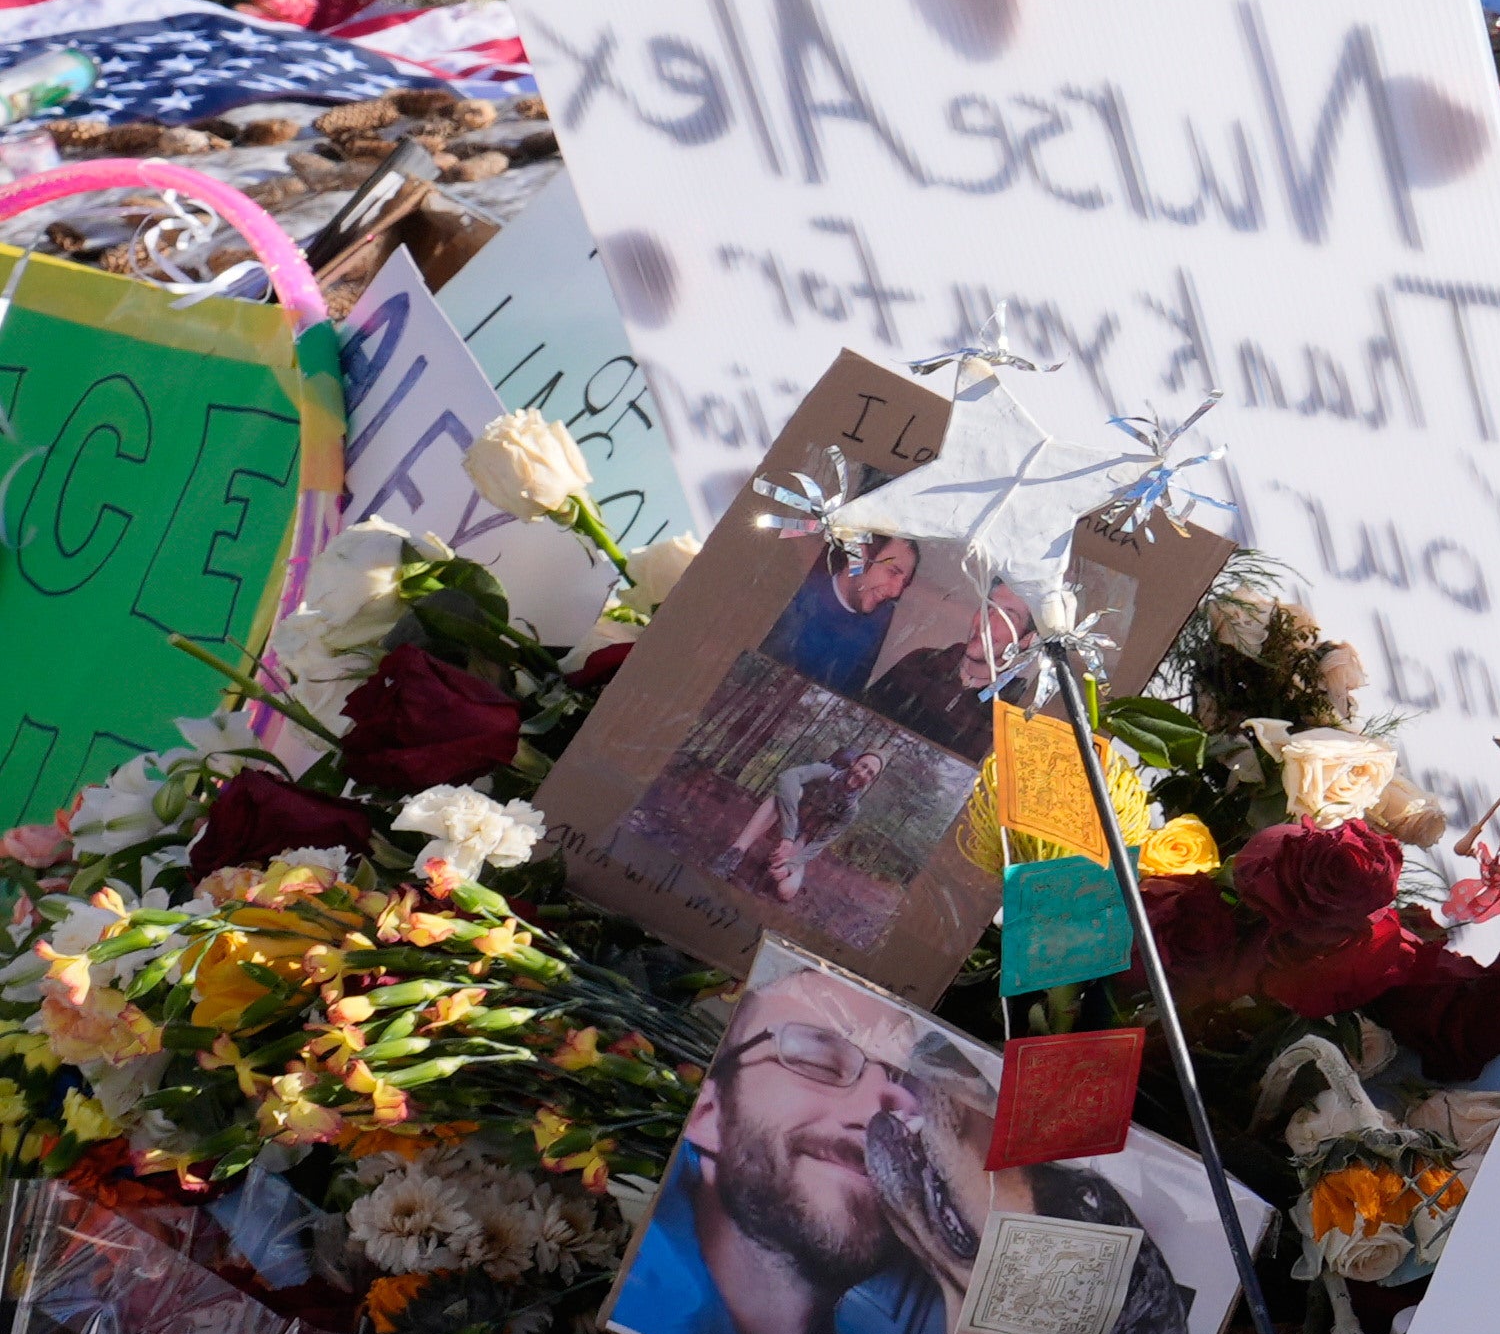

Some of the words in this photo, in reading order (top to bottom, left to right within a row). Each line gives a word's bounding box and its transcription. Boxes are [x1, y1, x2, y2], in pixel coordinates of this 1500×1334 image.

[840, 393, 890, 445] I
[546, 821, 608, 871] and
[621, 859, 678, 898] will
